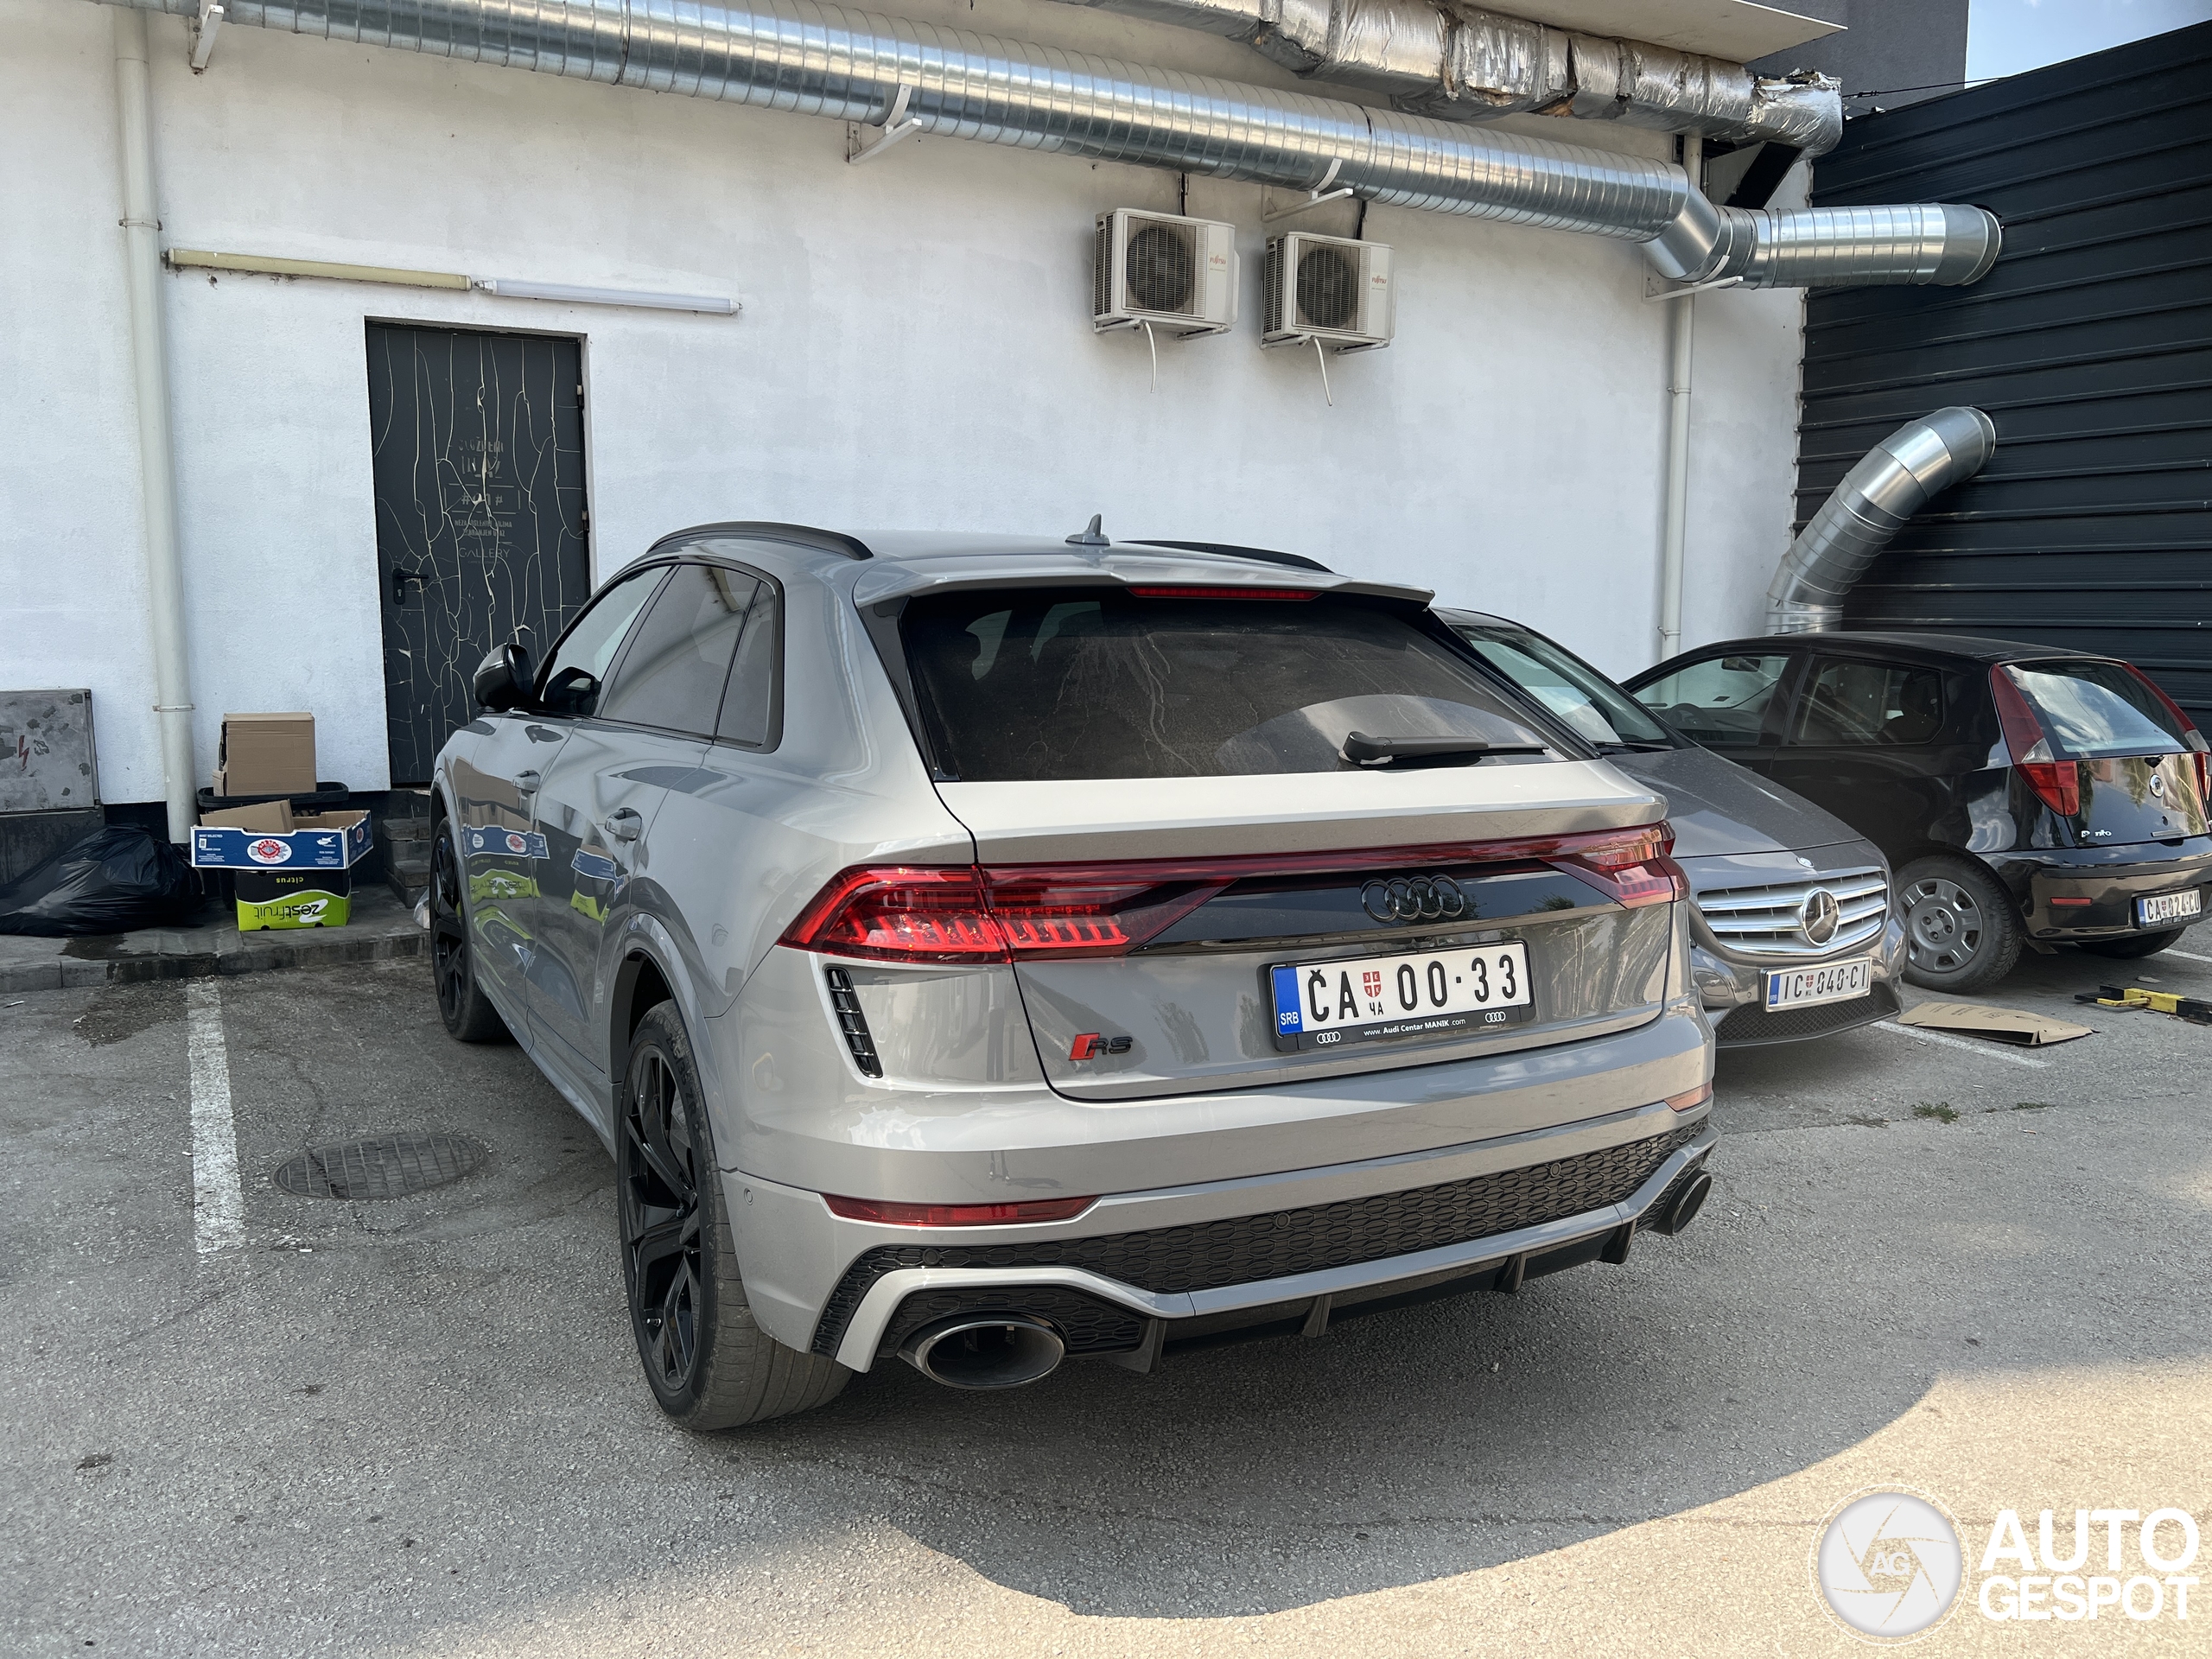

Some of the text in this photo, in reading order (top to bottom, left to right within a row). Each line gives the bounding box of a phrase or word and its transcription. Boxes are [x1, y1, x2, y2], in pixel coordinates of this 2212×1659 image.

[459, 547, 511, 558] GALLERY
[253, 904, 320, 921] zestfruit
[1308, 969, 1359, 1022] ČA
[1280, 1011, 1300, 1026] SRB
[1363, 1027, 1382, 1037] www.
[1382, 1026, 1400, 1034] Audi
[1401, 1023, 1423, 1032] Centar
[1424, 1019, 1450, 1029] MANIK
[1085, 1036, 1134, 1056] RS
